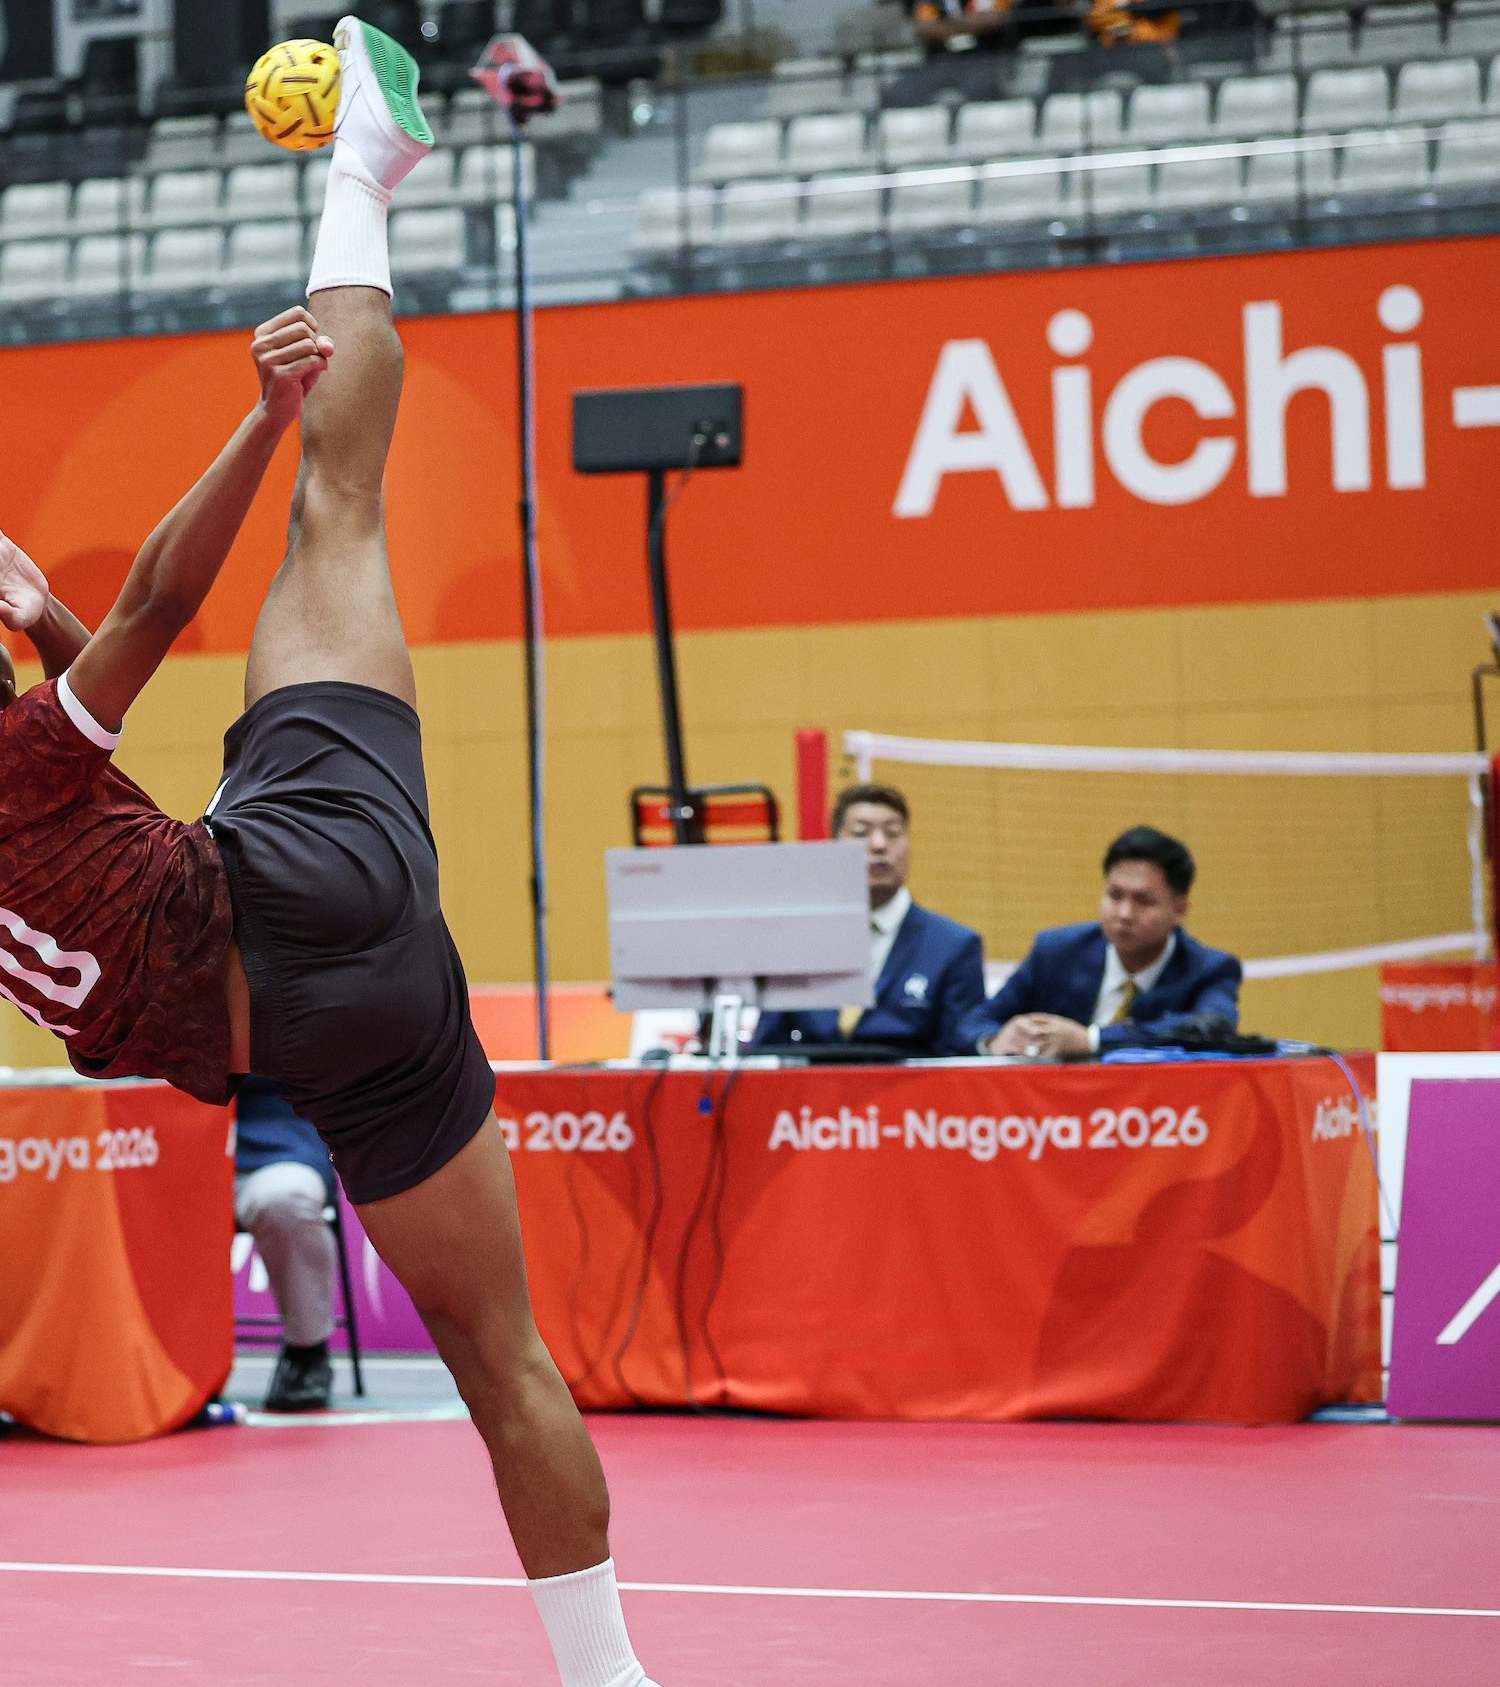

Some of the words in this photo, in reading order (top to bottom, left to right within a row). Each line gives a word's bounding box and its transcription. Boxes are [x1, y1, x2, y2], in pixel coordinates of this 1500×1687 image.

[892, 284, 1500, 518] Aichi-
[95, 1125, 160, 1171] 2026
[523, 1110, 636, 1152] 2026
[768, 1105, 1082, 1161] Aichi-Nagoya
[1088, 1105, 1209, 1149] 2026
